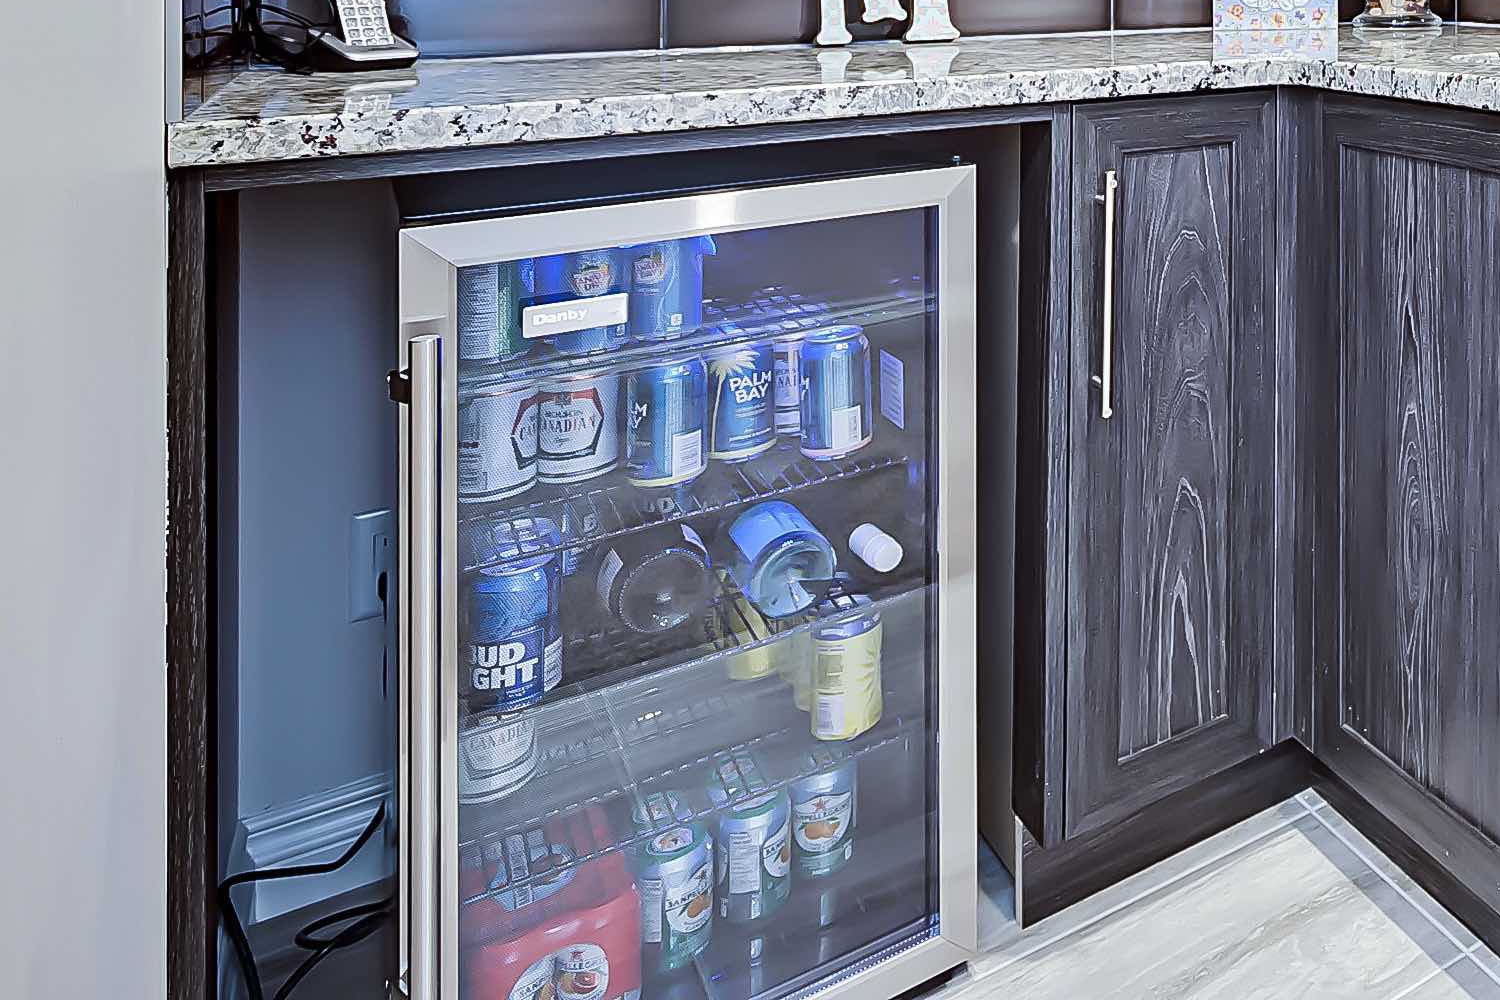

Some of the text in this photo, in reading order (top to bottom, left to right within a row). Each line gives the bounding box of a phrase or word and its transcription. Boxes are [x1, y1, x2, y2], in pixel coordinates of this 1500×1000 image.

[532, 308, 588, 327] Danby
[729, 370, 772, 392] PALM
[735, 383, 769, 404] BAY
[472, 657, 539, 690] GHT
